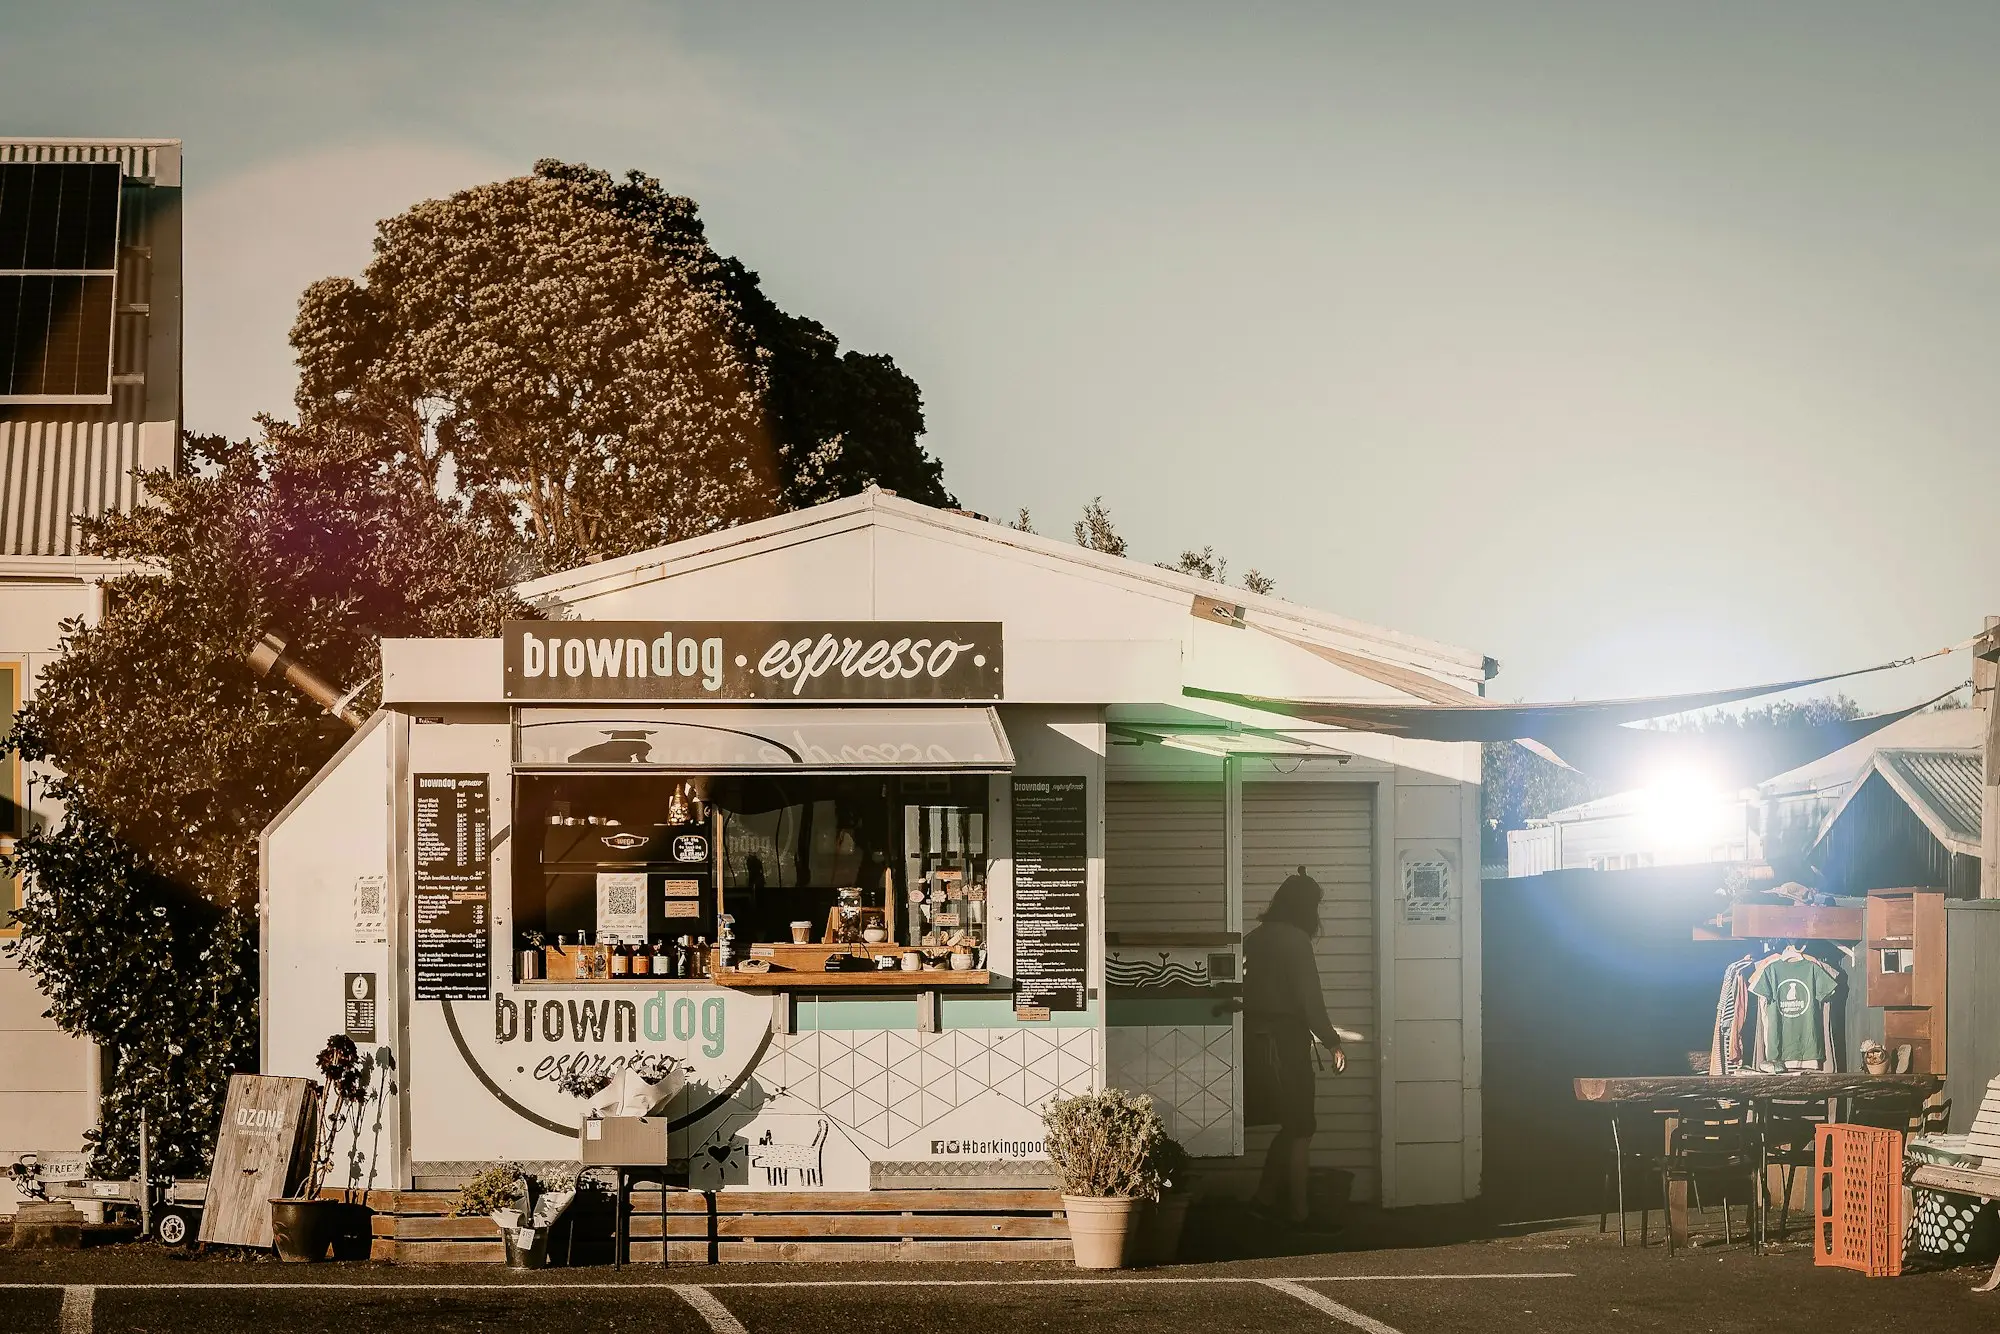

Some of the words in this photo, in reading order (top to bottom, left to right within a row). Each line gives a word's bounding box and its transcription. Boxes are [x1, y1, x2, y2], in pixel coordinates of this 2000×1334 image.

[523, 632, 723, 691] browndog
[756, 632, 974, 694] espresso
[420, 779, 456, 790] browndog
[1014, 782, 1050, 794] browndog
[496, 991, 725, 1058] browndog
[236, 1108, 285, 1128] OZONE
[50, 1164, 73, 1174] FREE
